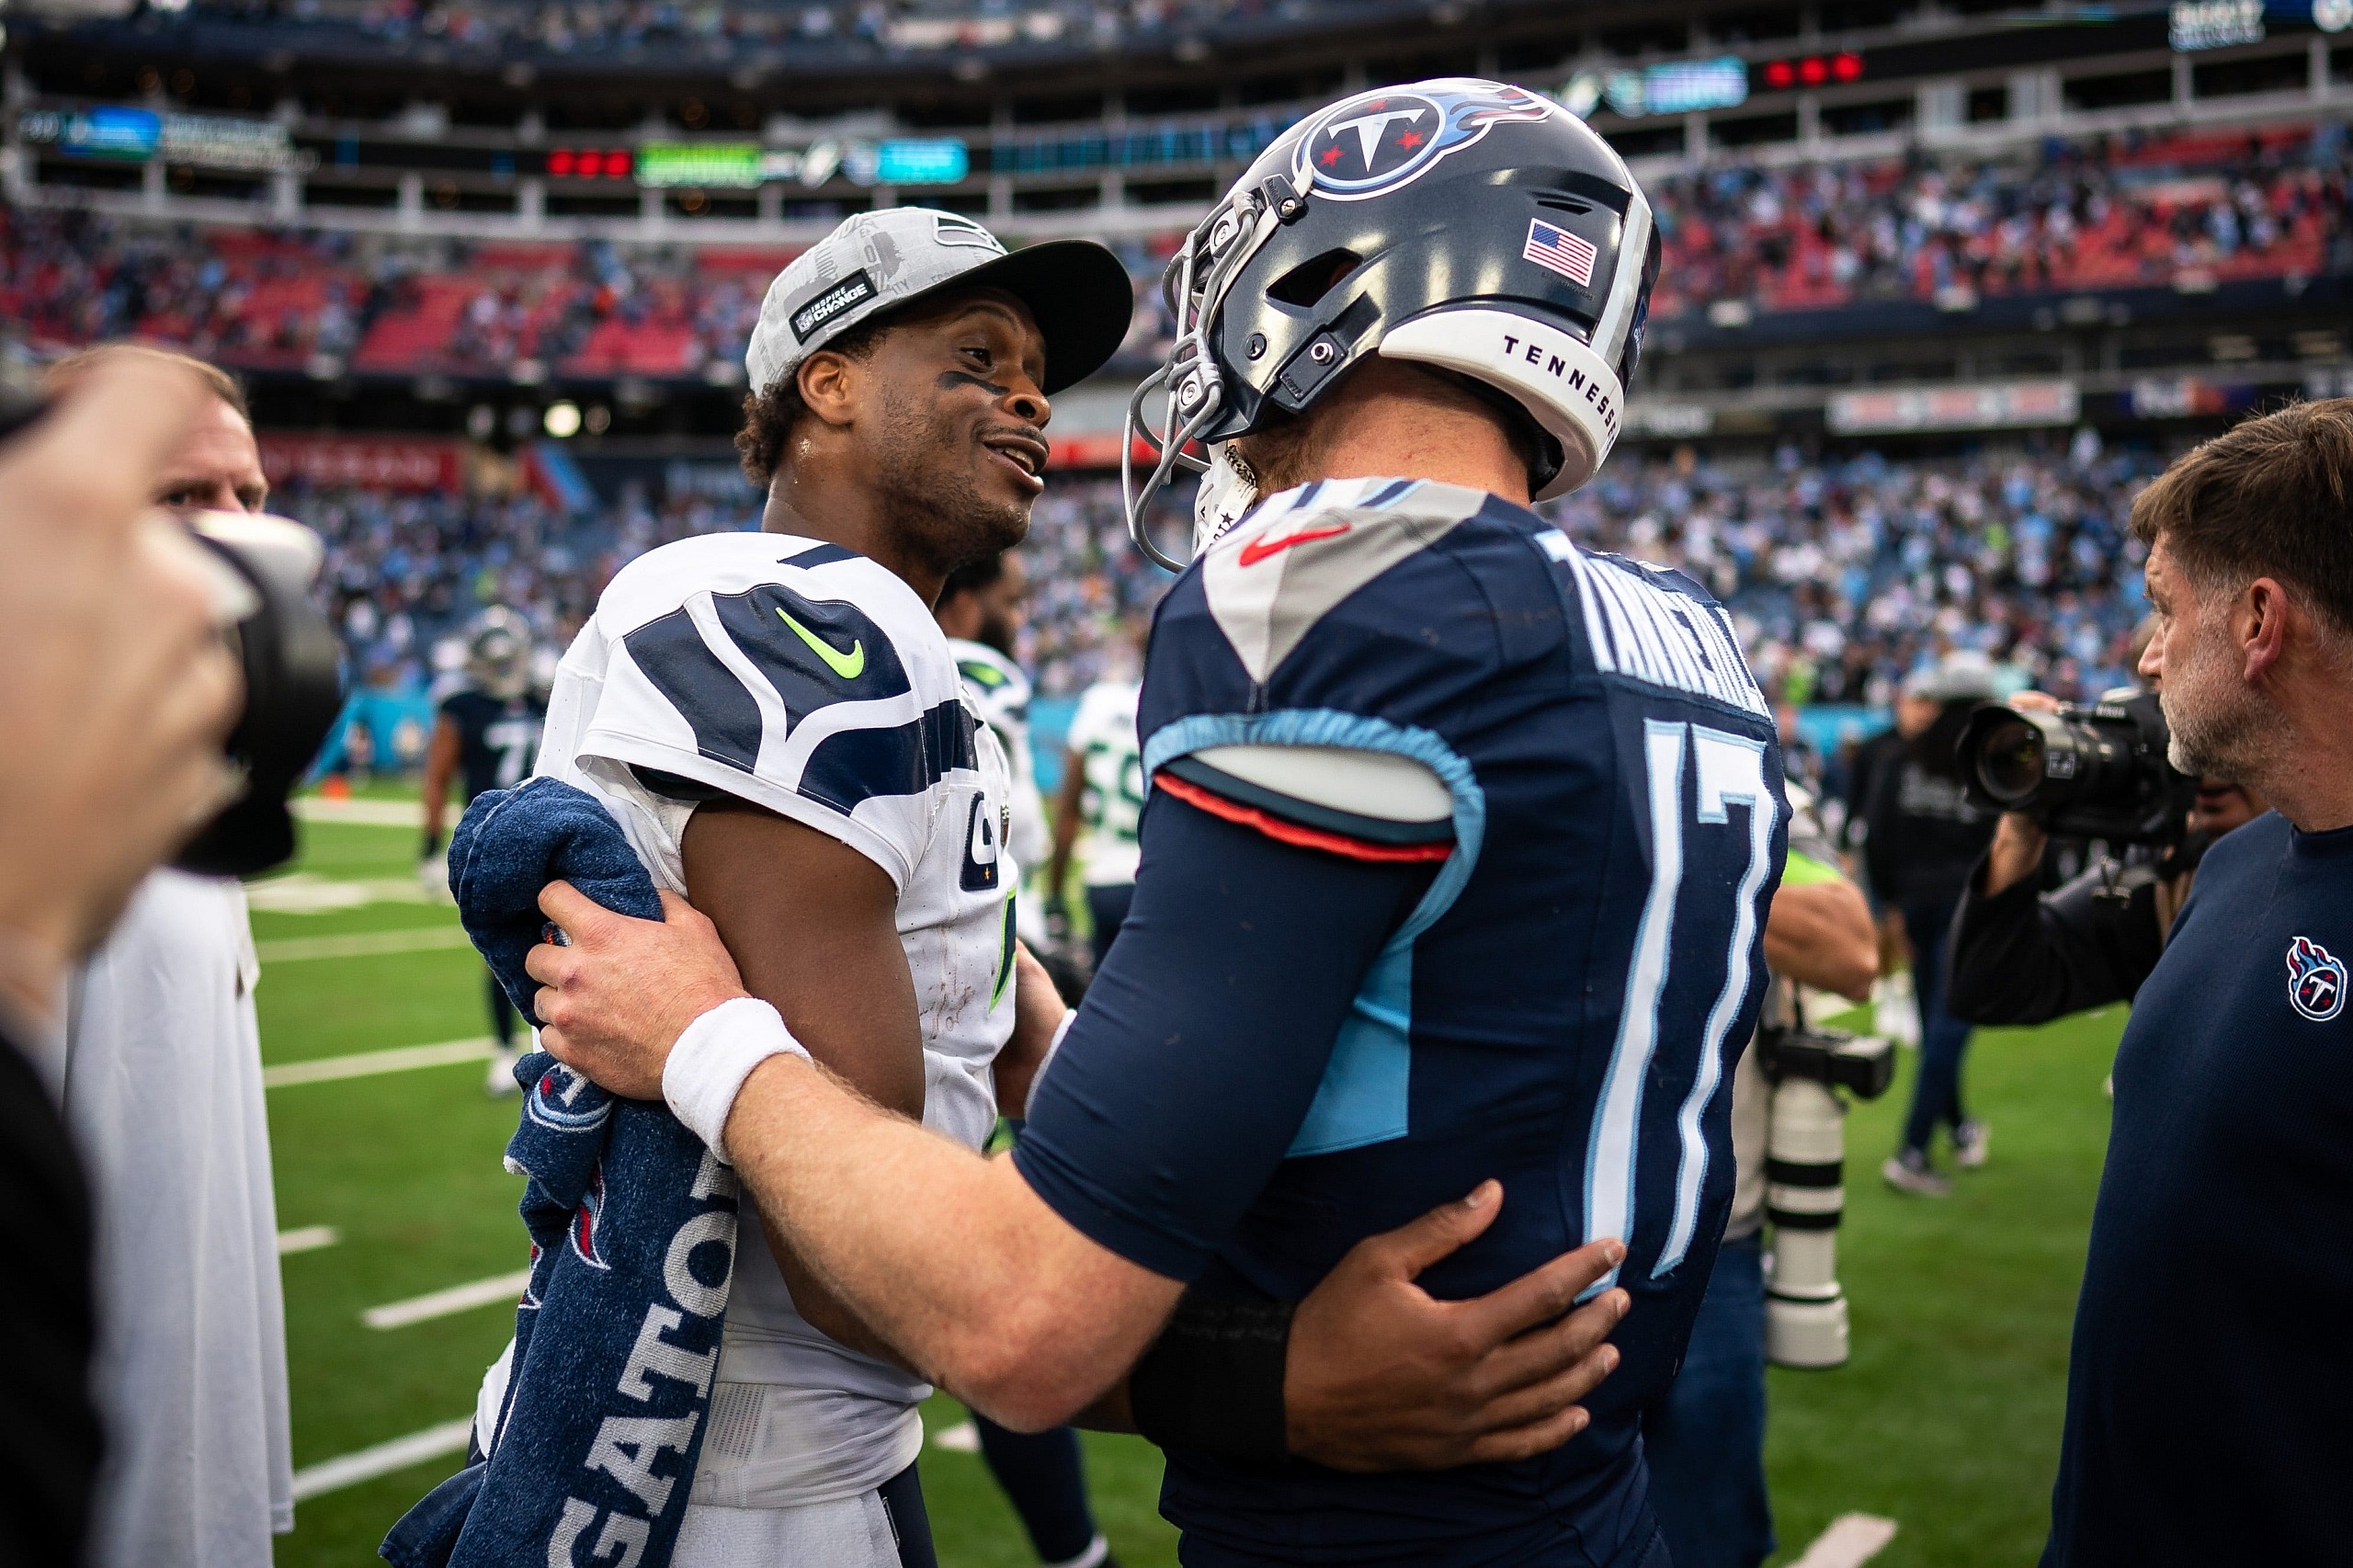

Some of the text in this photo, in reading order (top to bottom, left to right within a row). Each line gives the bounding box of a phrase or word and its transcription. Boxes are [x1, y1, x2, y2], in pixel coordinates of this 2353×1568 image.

[811, 286, 847, 312] INSPIRE
[813, 283, 868, 322] CHANGE
[1574, 712, 1779, 1303] 17
